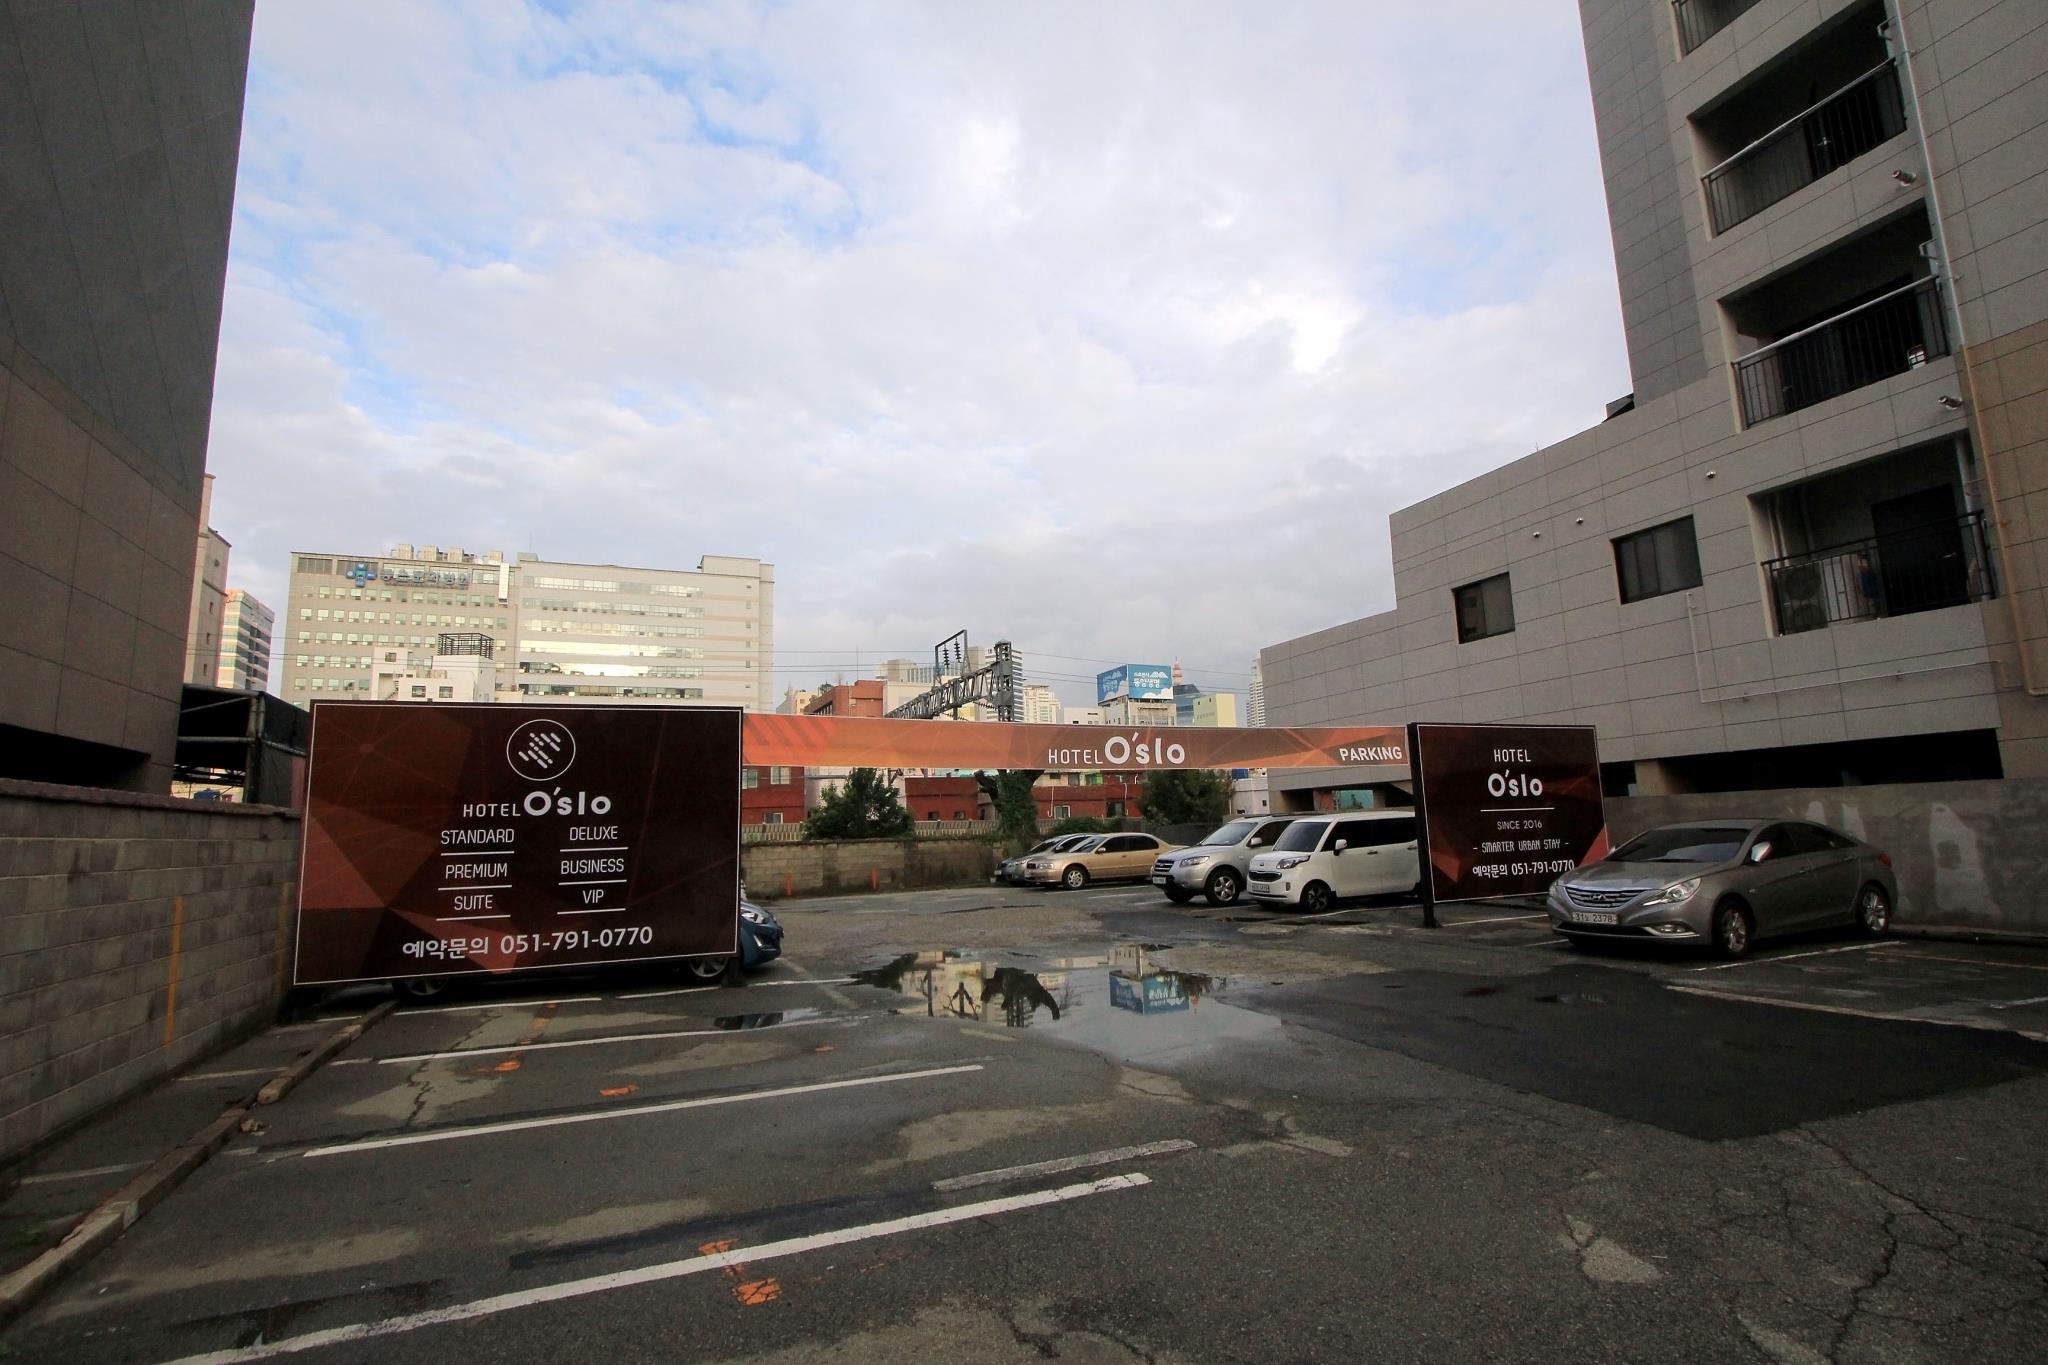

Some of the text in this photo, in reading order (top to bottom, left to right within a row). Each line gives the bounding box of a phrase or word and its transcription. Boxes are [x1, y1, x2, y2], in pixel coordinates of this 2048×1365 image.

[1048, 732, 1185, 764] HOTEL O'slo
[1339, 746, 1403, 761] PARKING
[1493, 749, 1532, 762] HOTEL
[1487, 769, 1543, 797] O'slo
[463, 787, 611, 818] HOTEL O'slo
[569, 826, 618, 841] DELUXE
[1497, 820, 1543, 830] SINCE 2016
[440, 829, 515, 845] STANDARD
[1481, 839, 1561, 853] SMARTER URBAN STAY
[445, 862, 508, 880] PREMIUM
[560, 858, 625, 875] BUSINESS
[1472, 859, 1575, 878] 예약문의 051-791-0770
[453, 894, 494, 911] SUITE
[582, 889, 605, 904] VIP
[402, 926, 653, 960] 예약문의 051-791-0770
